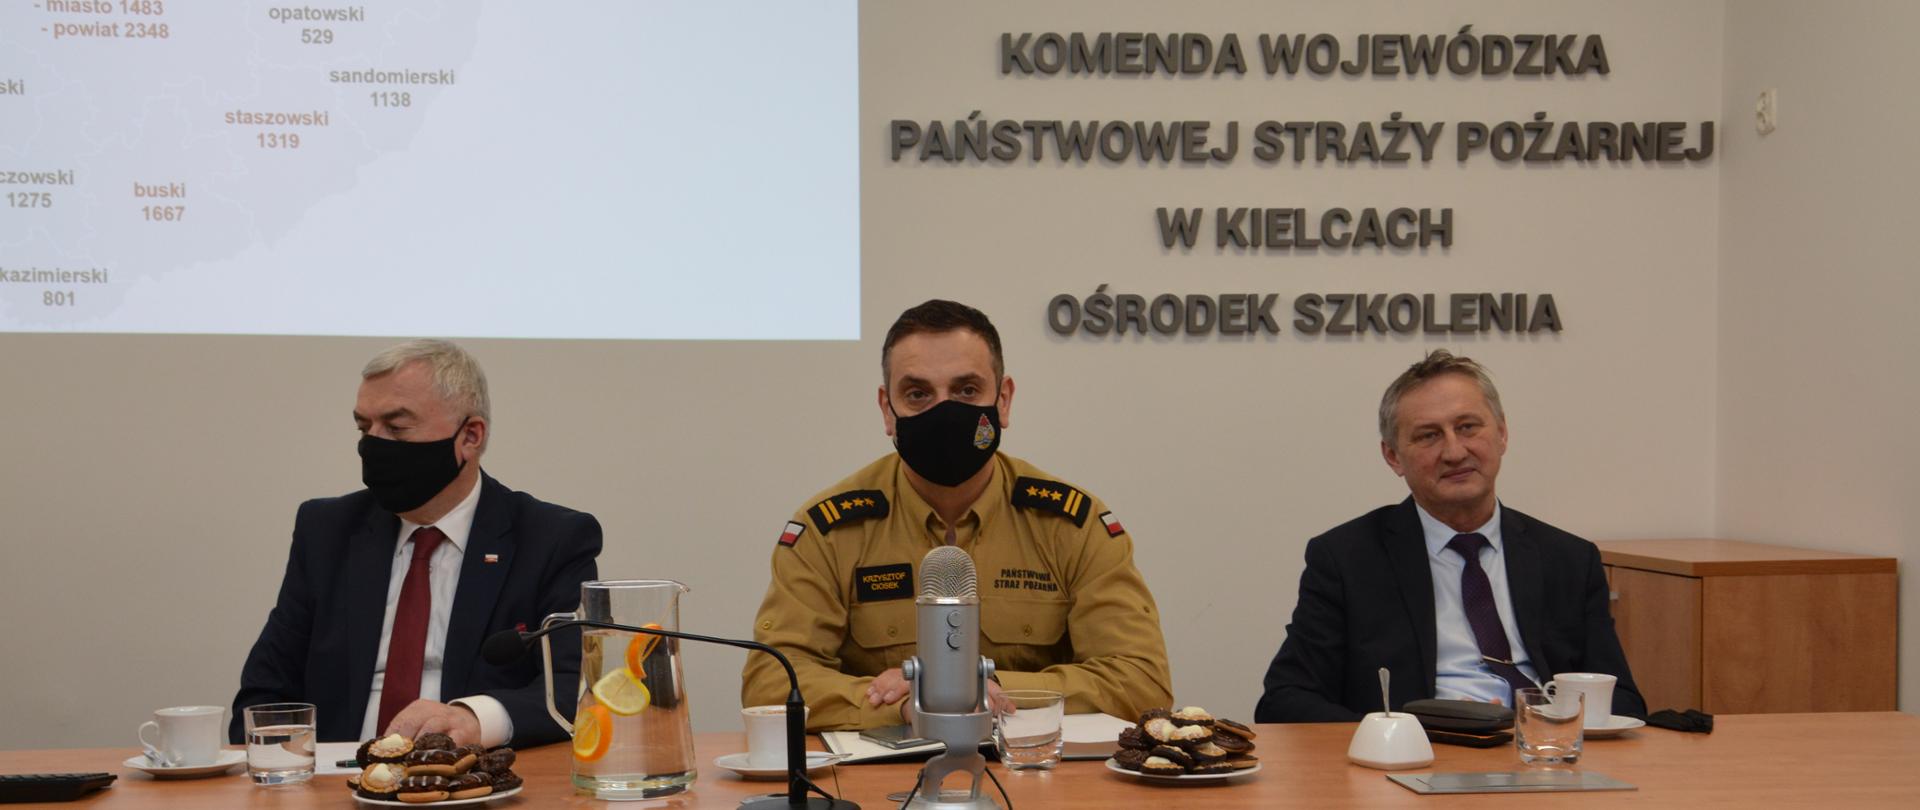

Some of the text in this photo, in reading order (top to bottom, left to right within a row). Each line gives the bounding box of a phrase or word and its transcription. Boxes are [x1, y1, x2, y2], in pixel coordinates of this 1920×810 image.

[46, 0, 113, 14] miasto
[119, 0, 164, 15] 1483
[268, 6, 365, 23] opatowski
[53, 22, 119, 39] powiat
[124, 22, 170, 39] 2348
[301, 28, 334, 45] 529
[1001, 25, 1610, 75] KOMENDA WOJEWÓDZKA
[329, 68, 456, 86] sandomierski
[370, 91, 411, 108] 1138
[225, 109, 329, 127] staszowski
[256, 132, 301, 149] 1319
[890, 110, 1715, 162] PAŃSTWOWEJ STRAŻY POŻARNEJ
[134, 181, 186, 198] buski
[6, 191, 53, 209] 1275
[141, 205, 186, 222] 1667
[1156, 207, 1454, 249] W KIELCACH
[0, 266, 109, 284] kazimierski
[42, 290, 76, 307] 801
[1047, 283, 1564, 335] OŚRODEK SZKOLENIA
